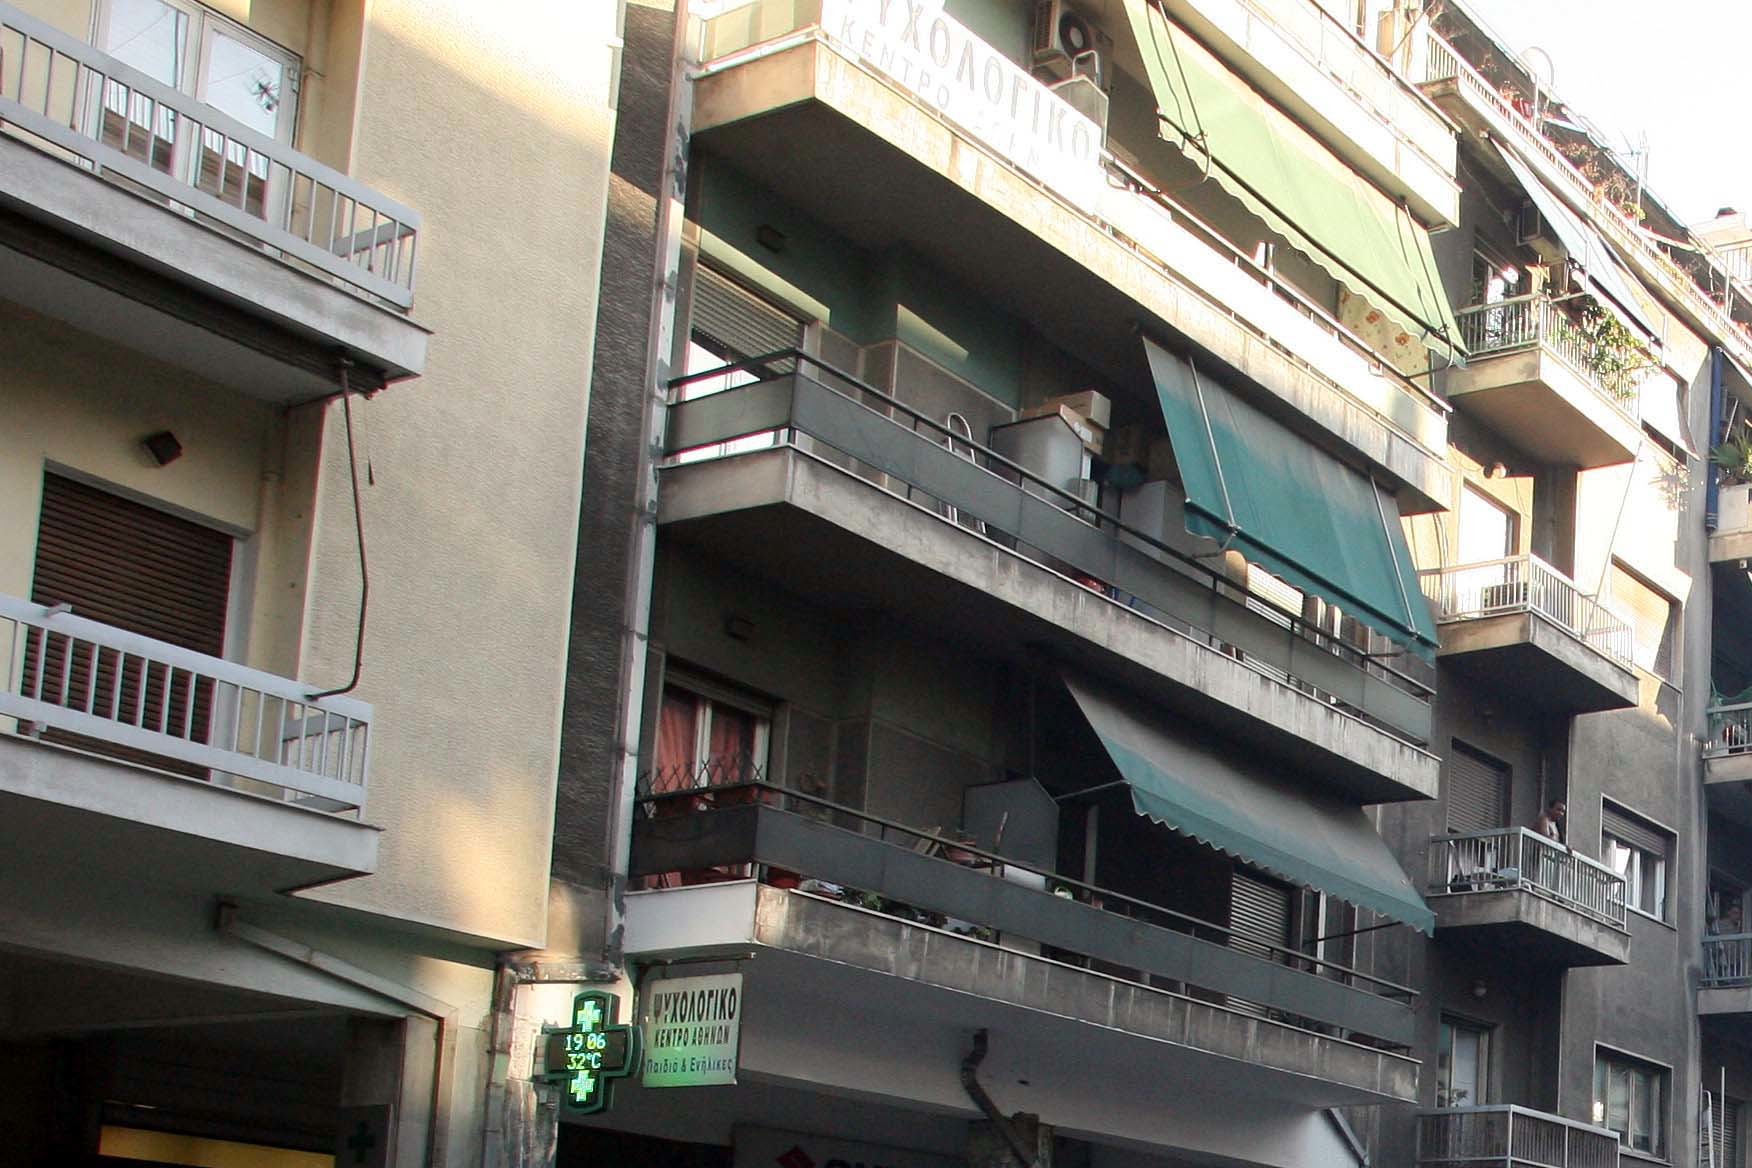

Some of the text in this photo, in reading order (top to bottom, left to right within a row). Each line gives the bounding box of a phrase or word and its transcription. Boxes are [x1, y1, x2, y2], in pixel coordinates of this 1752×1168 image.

[839, 14, 951, 110] ΚΕΝΤΡΟ
[878, 0, 1092, 162] ΥΧΟΛΟΓΙΚΟ
[654, 987, 737, 1024] ΨΥΧΟΛΟΓΙΚΟ
[655, 1025, 730, 1048] ΚΕΝΤΡΟ ΑΘΗΝΩΝ
[689, 1055, 736, 1075] Ενήλικες
